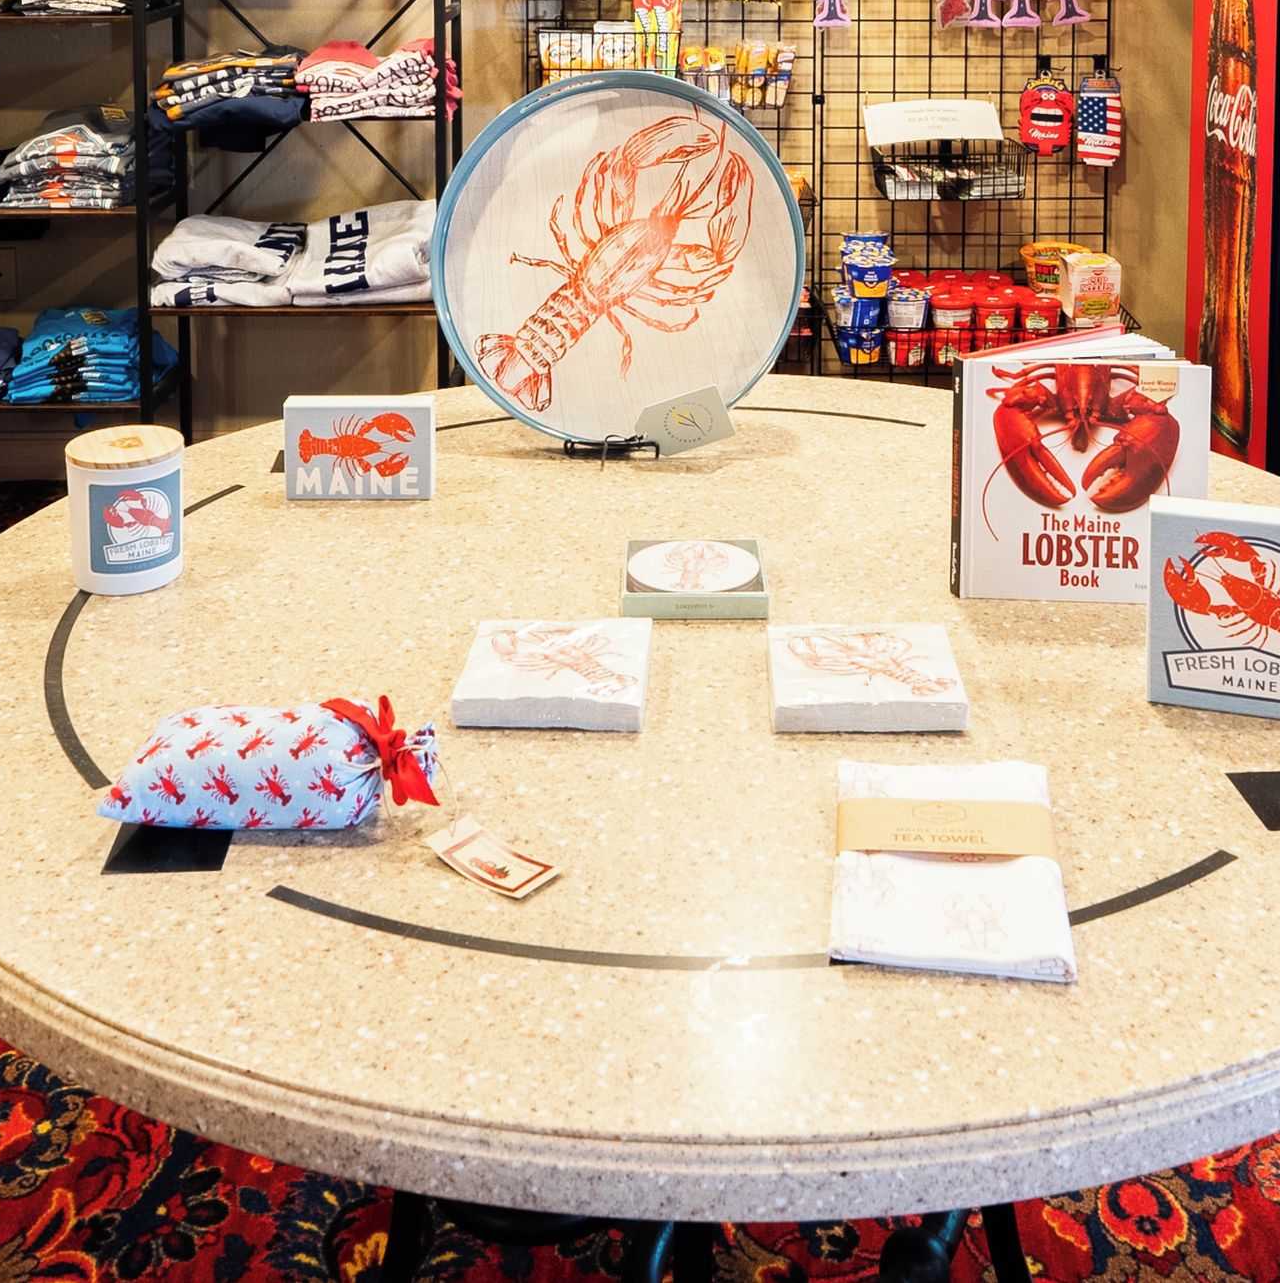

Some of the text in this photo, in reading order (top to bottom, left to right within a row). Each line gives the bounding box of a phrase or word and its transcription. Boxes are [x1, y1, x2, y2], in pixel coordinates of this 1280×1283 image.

[1206, 75, 1257, 158] Coca-Cola
[1029, 128, 1060, 140] Maine
[1035, 264, 1055, 275] HOT
[296, 467, 420, 496] MAINE
[1042, 513, 1121, 534] The Maine
[128, 548, 157, 559] MAINE
[1022, 535, 1139, 569] LOBSTER
[1060, 569, 1100, 589] Book
[1173, 655, 1235, 674] FRESH
[1222, 675, 1278, 693] MAINE
[891, 834, 990, 845] TEA TOWEL
